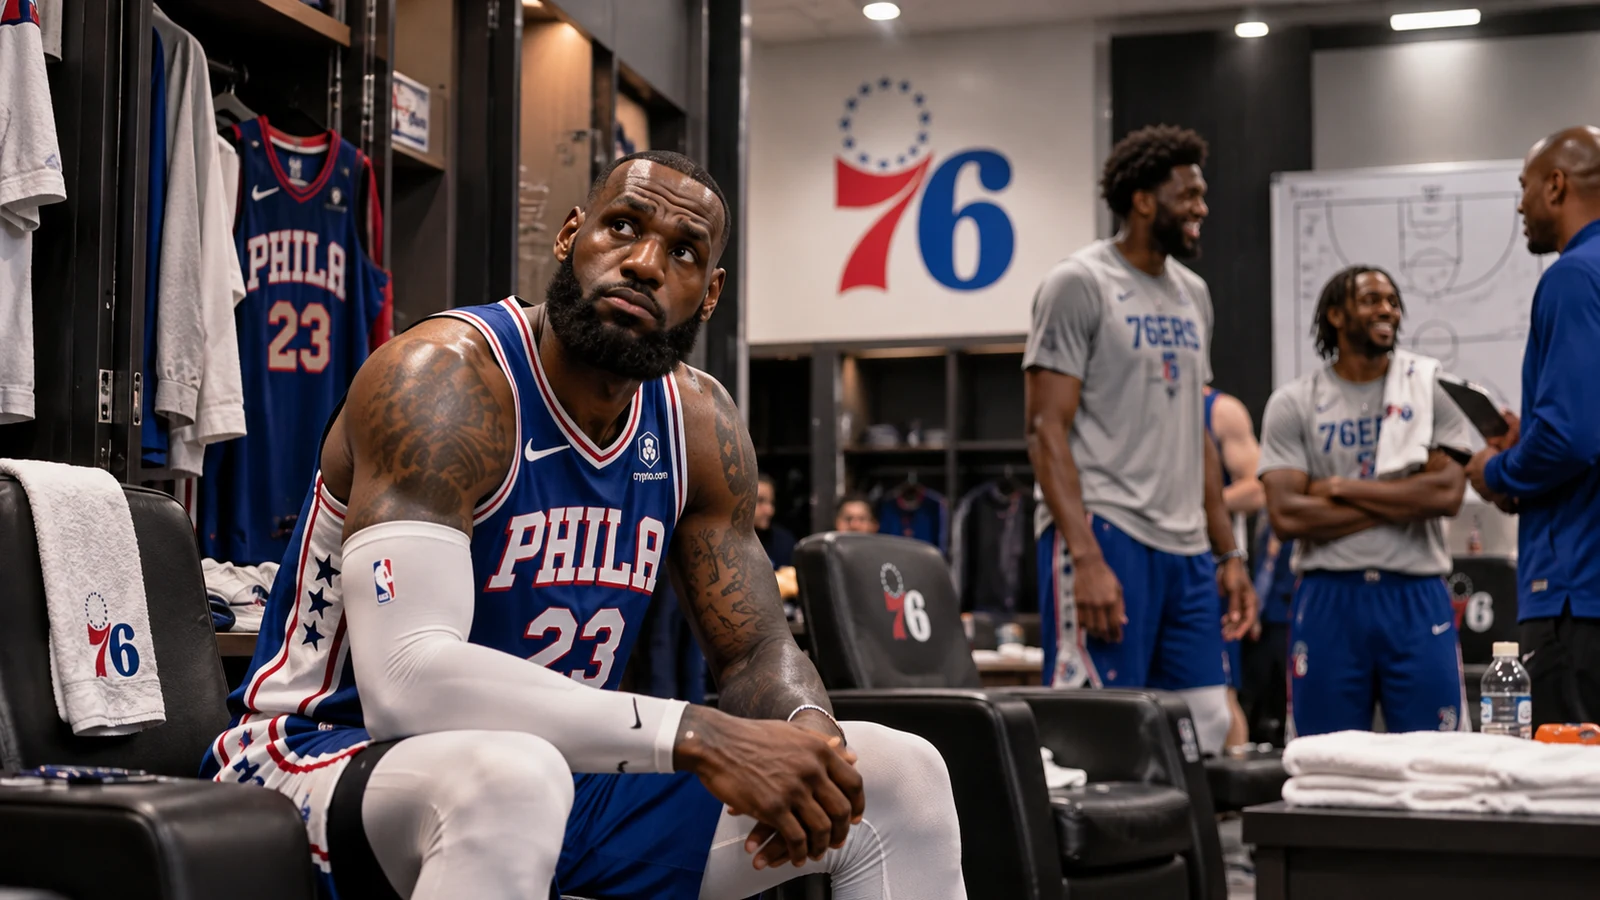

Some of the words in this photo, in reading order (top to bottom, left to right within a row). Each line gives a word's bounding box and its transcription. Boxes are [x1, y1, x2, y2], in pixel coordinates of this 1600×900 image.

[835, 147, 1016, 294] 76
[247, 229, 346, 302] PHILA
[268, 300, 330, 373] 23
[1125, 315, 1199, 350] 76ERS
[1319, 416, 1382, 454] 76E
[483, 506, 665, 596] PHILA
[87, 622, 140, 678] 76
[523, 606, 626, 690] 23
[883, 589, 931, 642] 76
